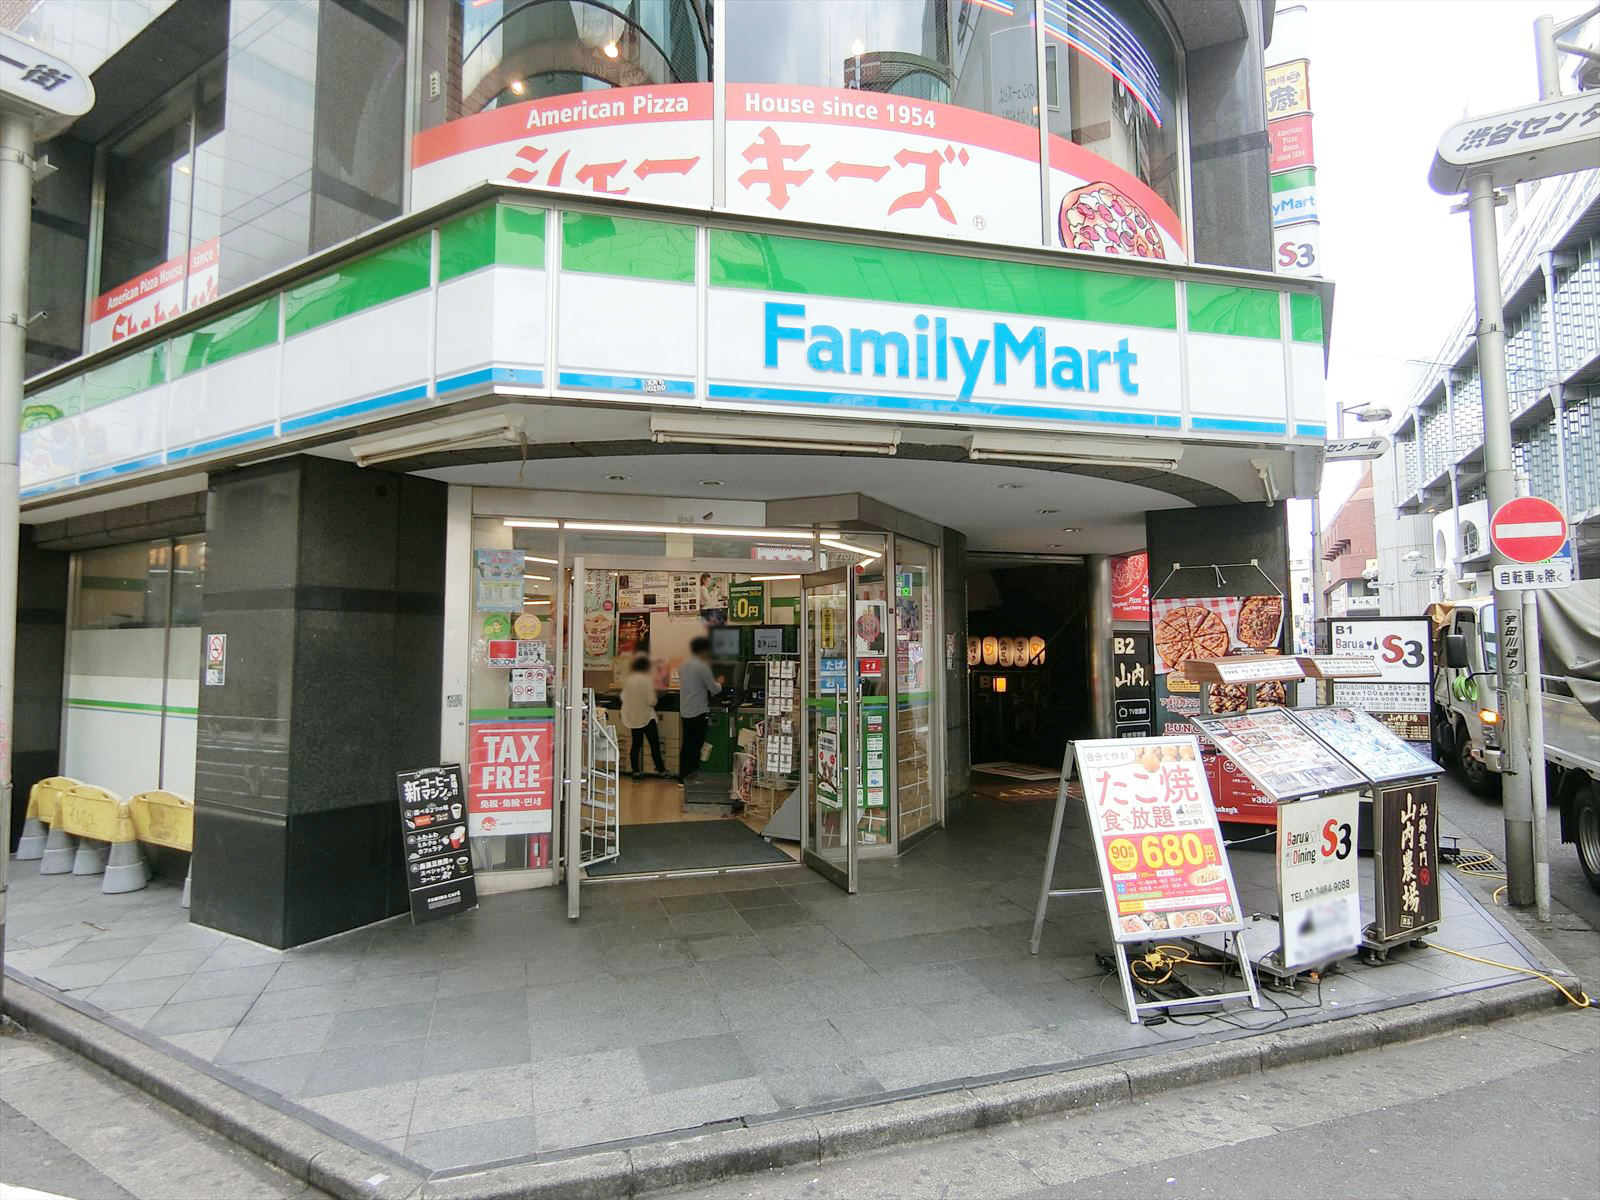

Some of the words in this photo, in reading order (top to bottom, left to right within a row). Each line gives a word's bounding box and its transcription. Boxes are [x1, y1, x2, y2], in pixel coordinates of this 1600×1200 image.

[526, 100, 625, 129] American
[633, 94, 689, 114] Pizza
[745, 93, 815, 114] House
[822, 96, 878, 120] since
[886, 103, 936, 128] 1954
[1278, 241, 1315, 268] S3
[107, 286, 139, 310] American
[140, 276, 159, 294] Pizza
[160, 263, 183, 284] House
[192, 249, 214, 268] since
[763, 301, 1139, 402] FamilyMart
[1501, 569, 1563, 585] 自転車を除く
[738, 598, 758, 618] 0円
[1336, 626, 1353, 634] B1
[1504, 615, 1519, 670] 宇田川通り
[1114, 637, 1135, 654] B2
[1381, 634, 1425, 668] S3
[825, 660, 846, 671] たば
[1115, 662, 1150, 688] 山内
[483, 735, 541, 763] TAX
[420, 776, 450, 789] コーヒー
[482, 765, 541, 790] FREE
[1096, 765, 1199, 806] たこ焼
[404, 781, 421, 803] 新
[421, 787, 448, 800] マシン
[1101, 805, 1175, 833] 食べ放題
[1321, 818, 1352, 859] S3
[1293, 848, 1316, 864] Dining
[1401, 792, 1420, 912] 山内農場
